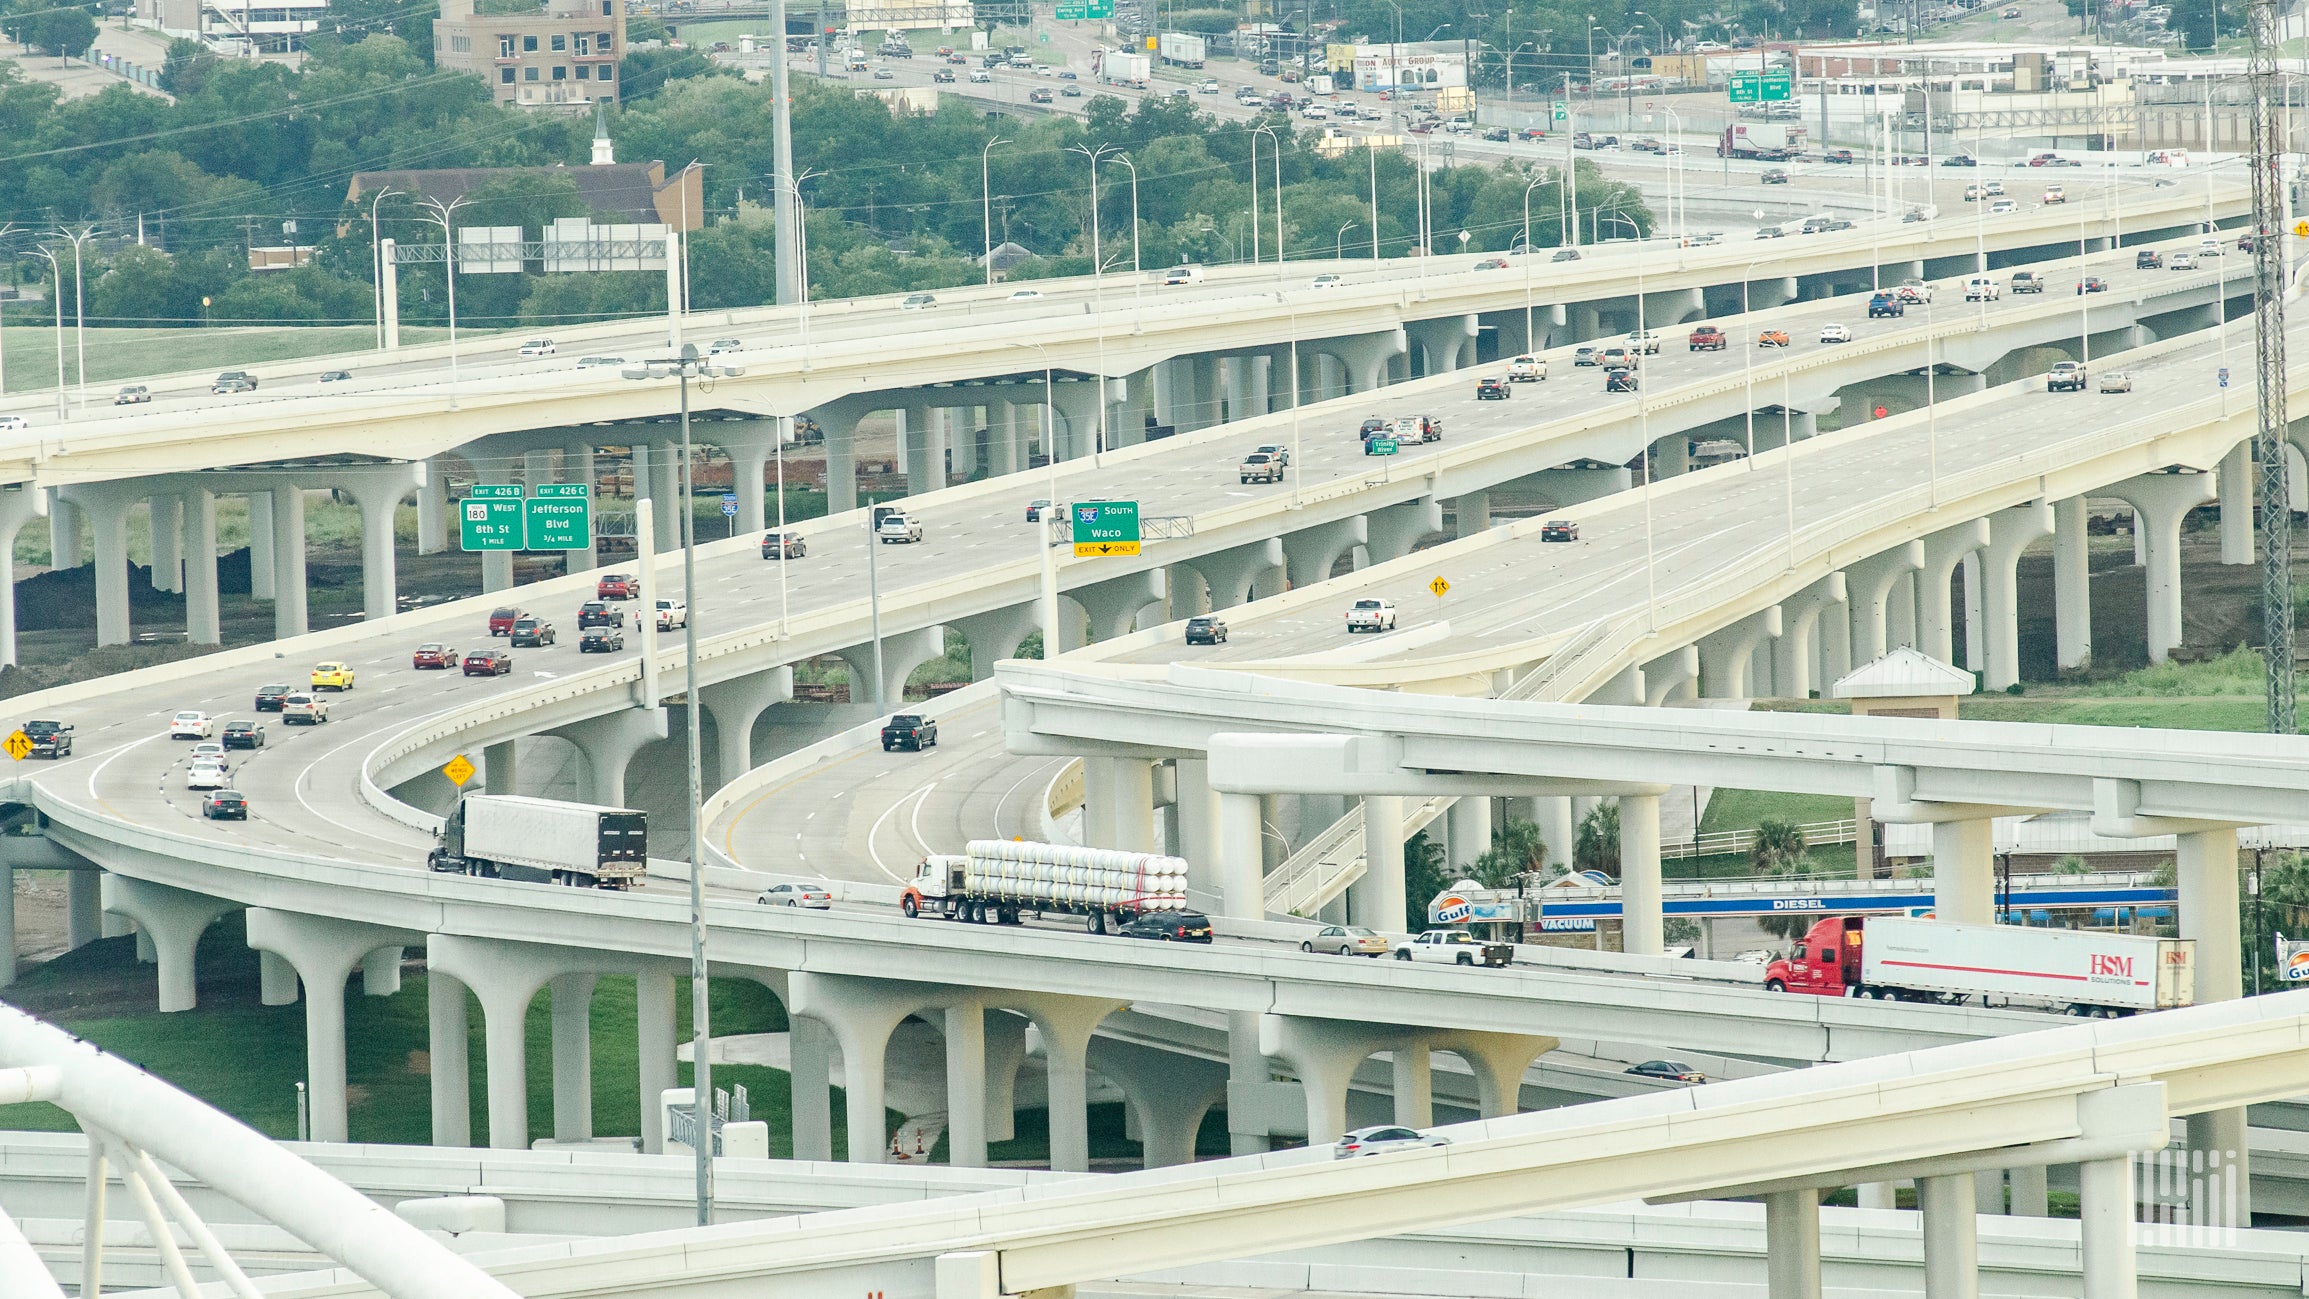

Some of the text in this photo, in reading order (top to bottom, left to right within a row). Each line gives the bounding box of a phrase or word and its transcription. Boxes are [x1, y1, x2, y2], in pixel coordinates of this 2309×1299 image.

[494, 487, 512, 496] 426
[514, 487, 520, 495] B
[559, 487, 577, 495] 426
[578, 486, 585, 495] C
[468, 504, 516, 519] 180 WEST
[531, 504, 583, 514] Jefferson
[1080, 511, 1097, 520] 35E
[1104, 506, 1133, 515] SOUTH
[545, 519, 570, 529] Blvd
[475, 525, 509, 534] 8th St
[1091, 528, 1122, 538] Waco
[482, 537, 487, 545] 1
[1773, 898, 1826, 910] DIESEL
[1437, 905, 1471, 923] Gulf
[1540, 919, 1595, 931] VACUUM
[2166, 951, 2186, 964] HSM
[2090, 954, 2134, 977] HSM
[2091, 976, 2131, 985] SOLUTIONS
